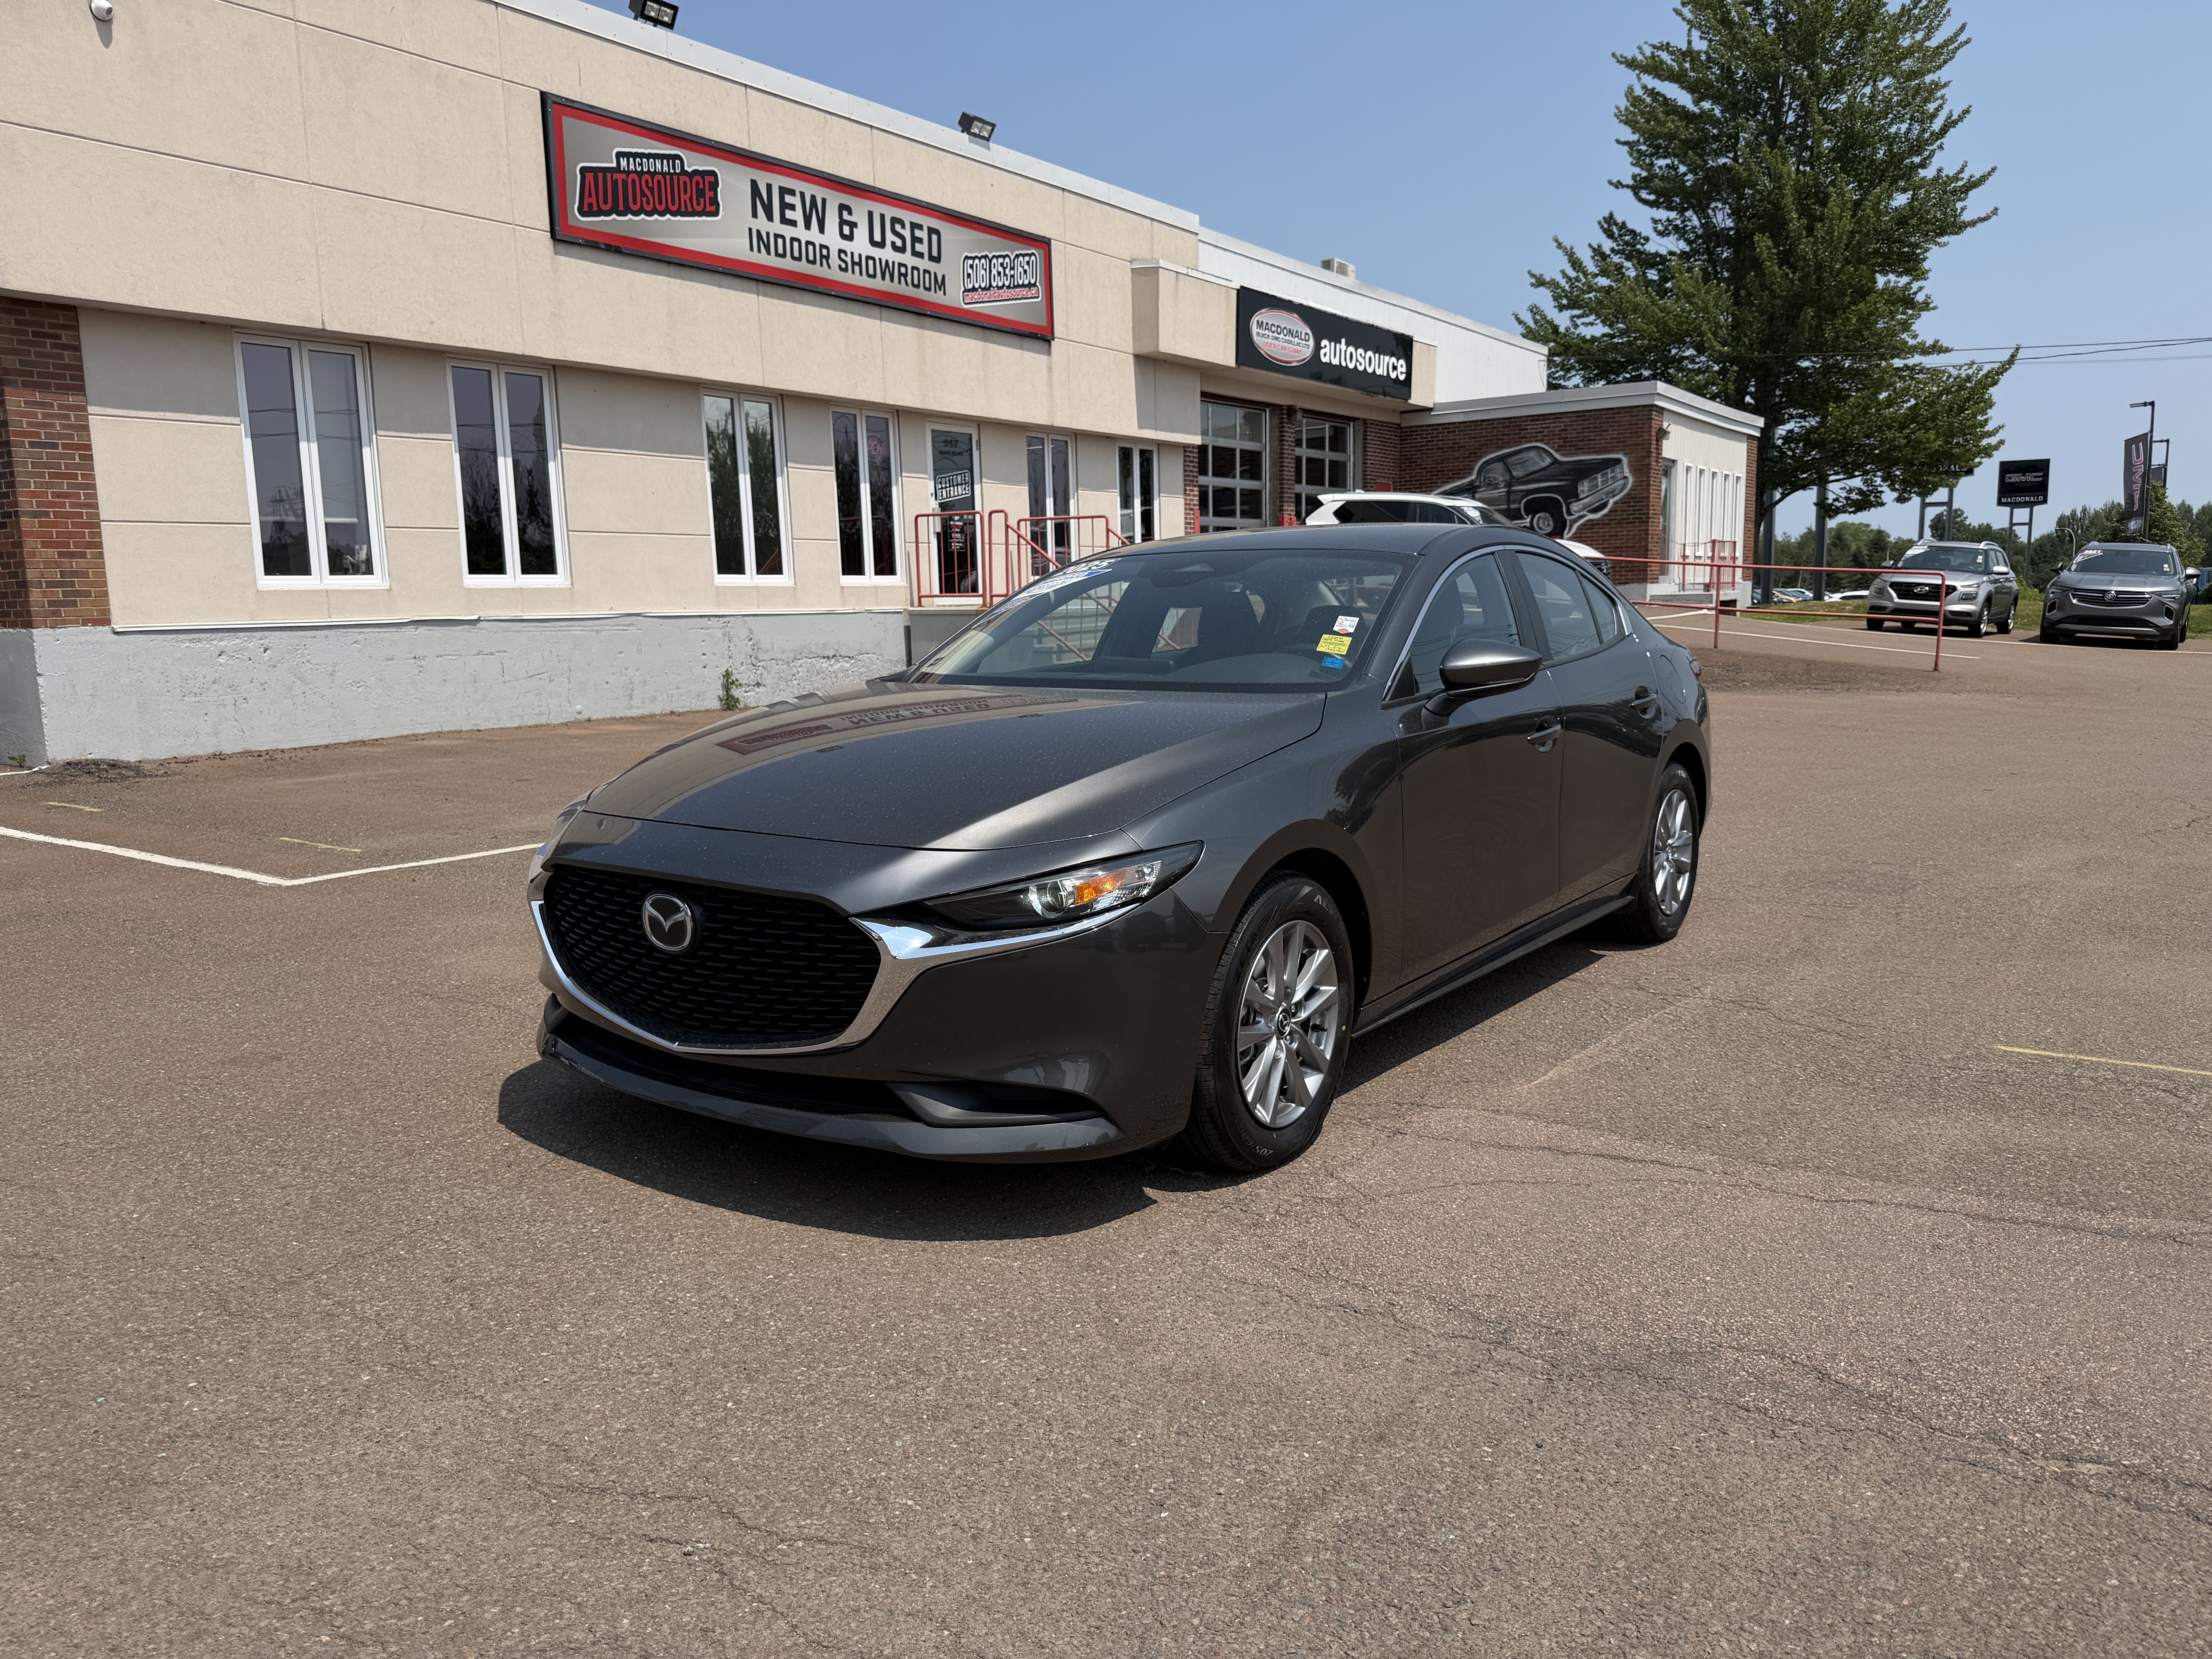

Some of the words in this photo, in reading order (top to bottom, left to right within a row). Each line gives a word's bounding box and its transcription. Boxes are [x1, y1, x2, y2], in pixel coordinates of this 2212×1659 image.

[620, 157, 682, 173] MACDONALD
[582, 172, 716, 211] AUTOSOURCE
[750, 178, 827, 235] NEW
[838, 203, 858, 242] &
[867, 210, 942, 264] USED
[748, 227, 832, 270] INDOOR
[837, 248, 947, 296] SHOWROOM
[964, 256, 990, 290] (506)
[990, 255, 1036, 288] 853-1650
[1256, 319, 1310, 342] MACDONALD
[1281, 337, 1302, 347] CADILLAC
[1319, 337, 1407, 381] autosource
[867, 441, 884, 456] PEN
[938, 472, 970, 489] CUSTOMER
[2004, 472, 2044, 483] GMC
[938, 484, 970, 500] ENTRANCE
